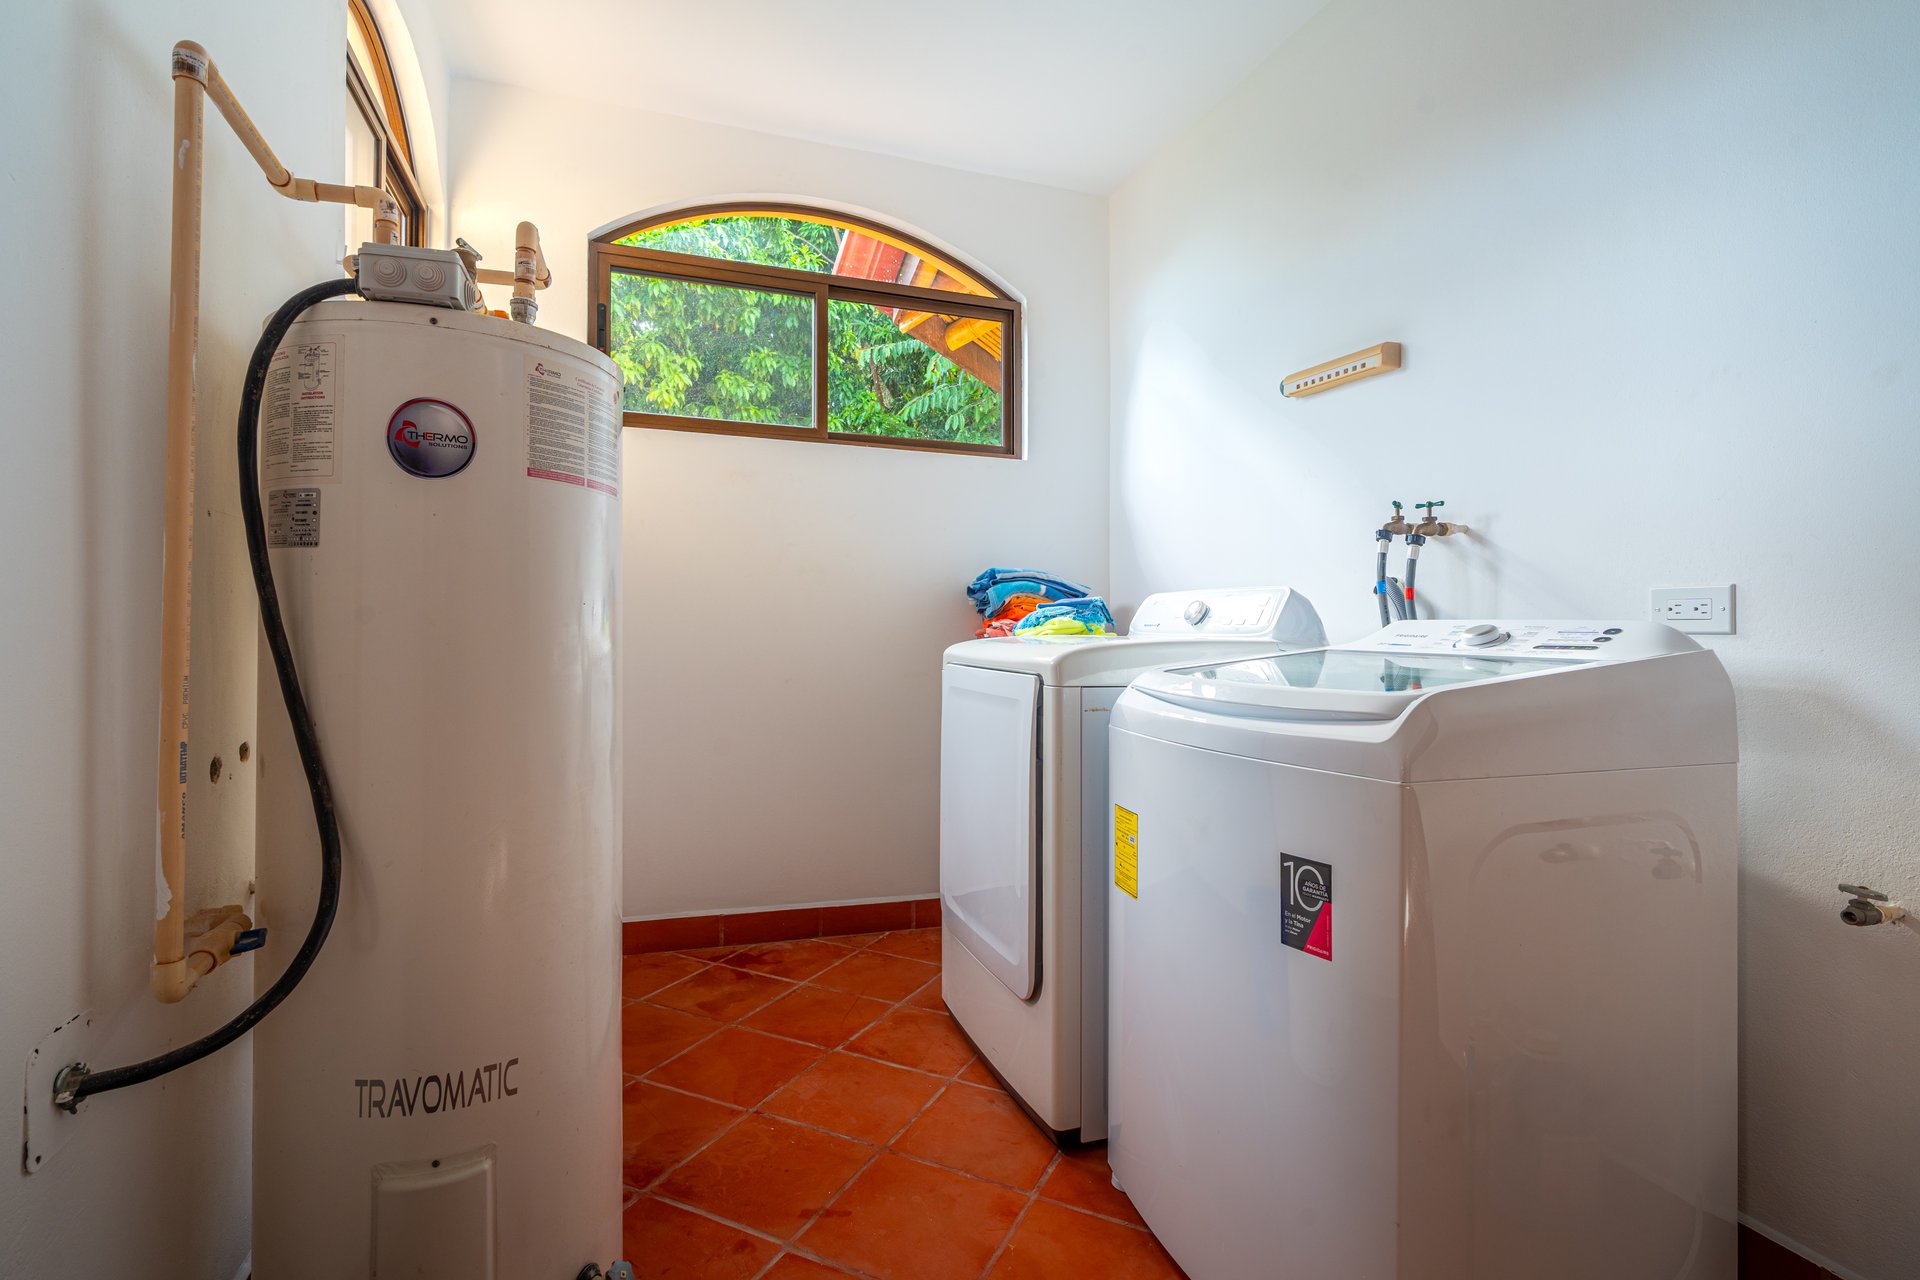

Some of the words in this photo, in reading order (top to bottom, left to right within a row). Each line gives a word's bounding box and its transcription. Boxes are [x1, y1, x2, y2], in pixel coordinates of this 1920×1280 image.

[407, 430, 469, 445] THERMO
[428, 442, 468, 450] SOLUTIONS
[1283, 861, 1325, 912] 10
[1293, 920, 1304, 928] Tina
[1296, 914, 1311, 923] Motor
[354, 1057, 519, 1119] TRAVOMATIC
